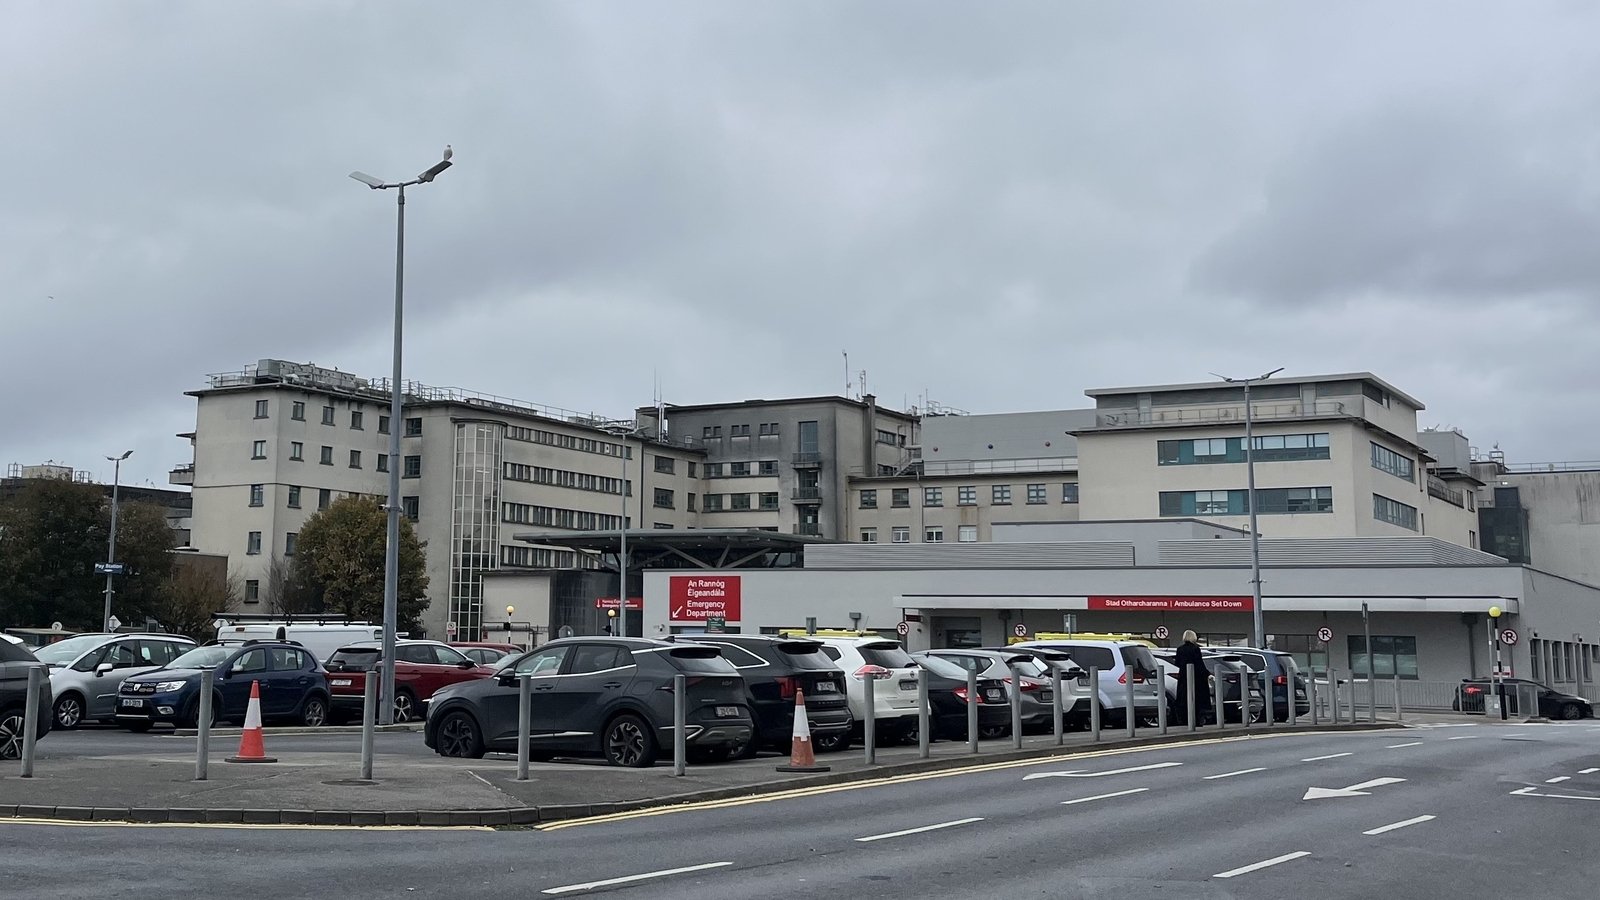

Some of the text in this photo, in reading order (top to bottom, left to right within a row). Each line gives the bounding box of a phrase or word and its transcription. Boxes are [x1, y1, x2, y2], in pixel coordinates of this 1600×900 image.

[698, 580, 725, 589] Rannóg
[687, 587, 725, 598] Éigeandála
[686, 600, 726, 610] Emergency
[686, 609, 726, 619] Department
